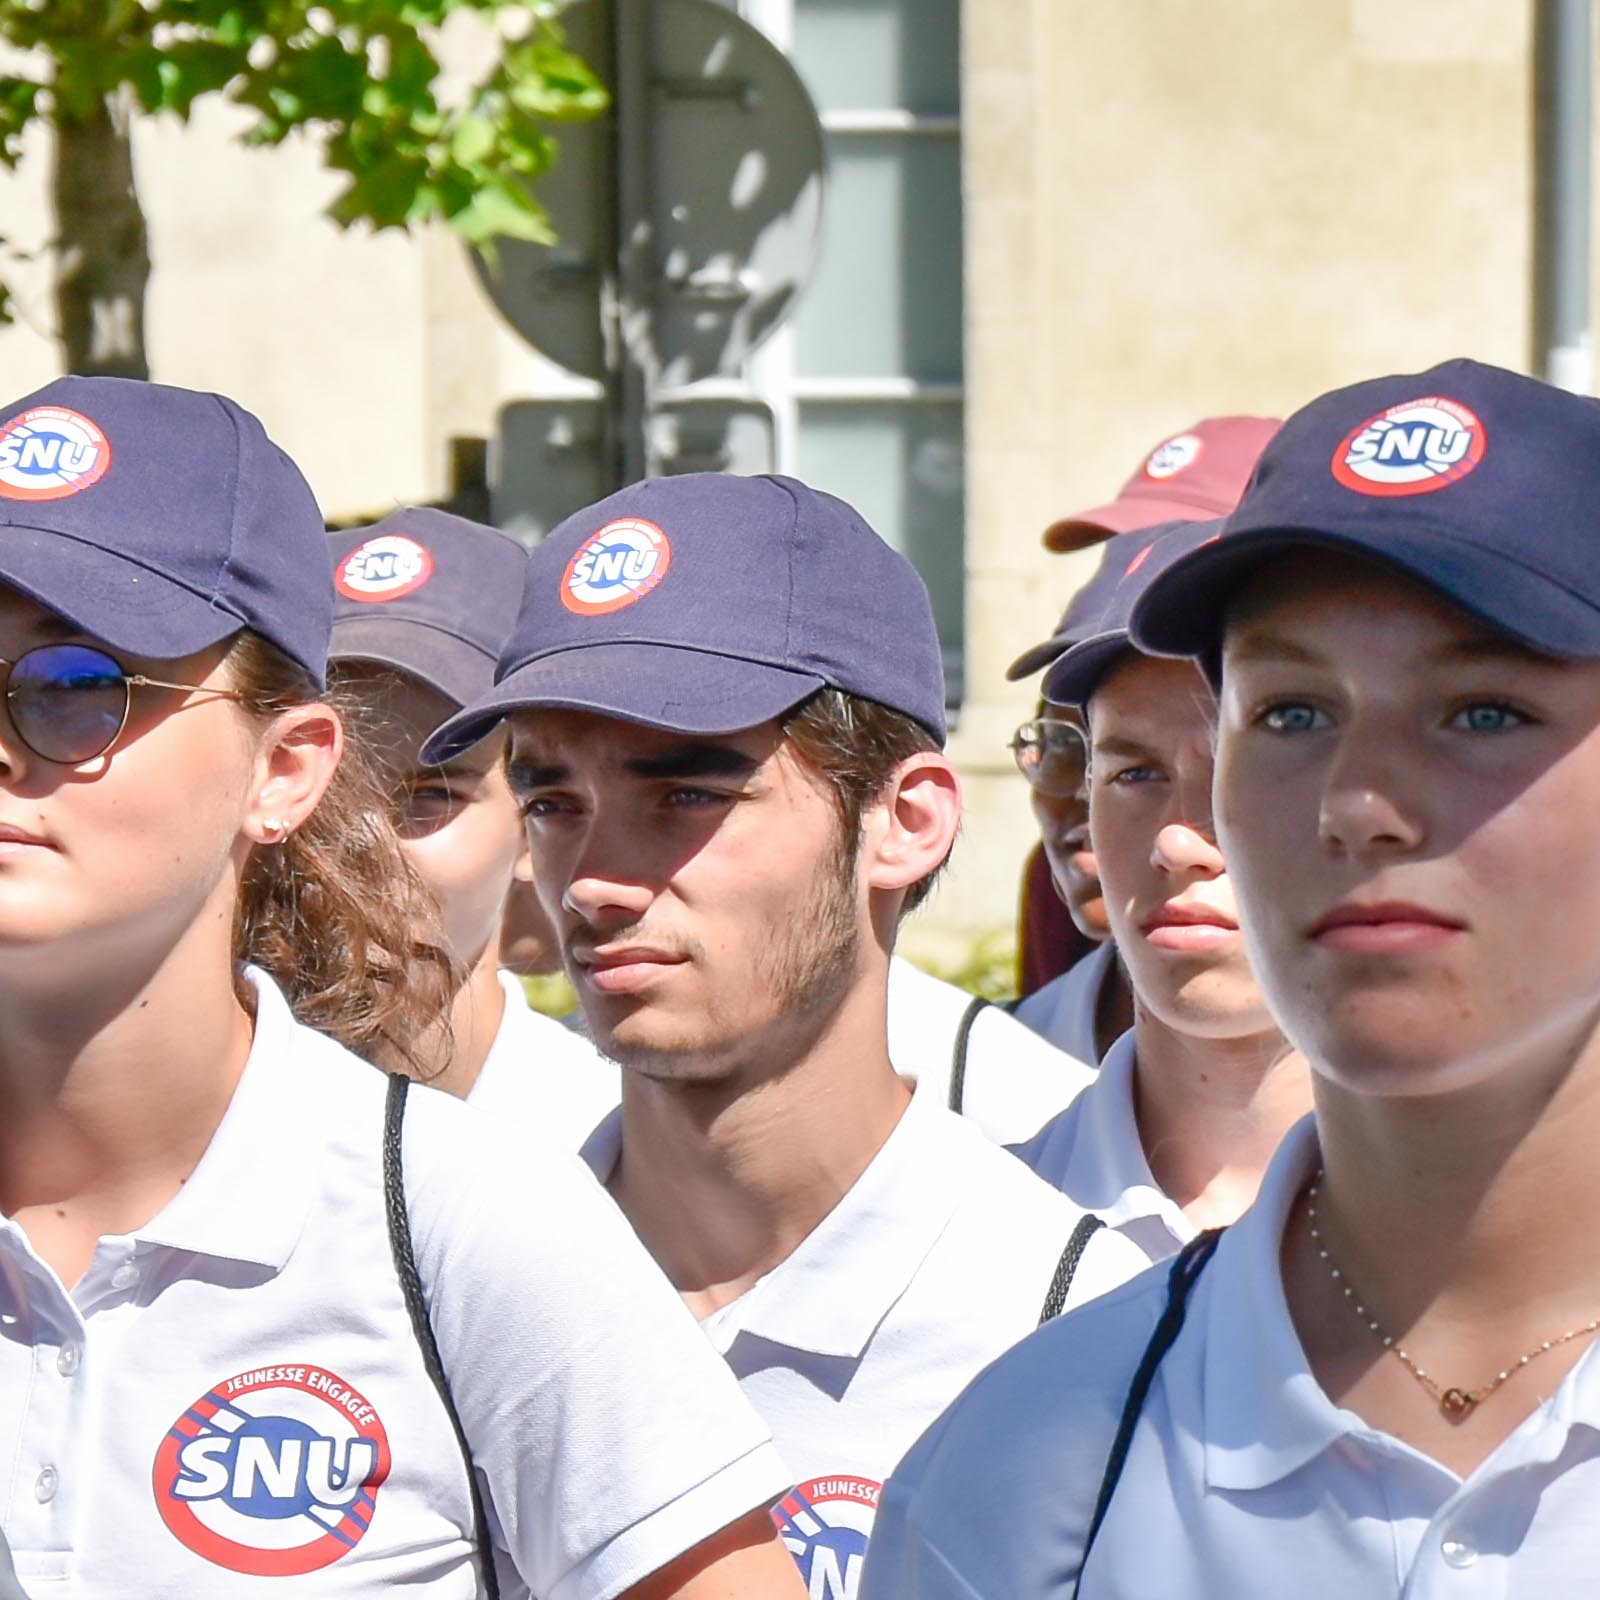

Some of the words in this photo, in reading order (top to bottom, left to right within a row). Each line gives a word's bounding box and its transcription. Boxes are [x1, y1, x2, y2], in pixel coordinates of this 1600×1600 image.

[1344, 427, 1473, 464] SNU
[343, 552, 423, 582] SNU
[568, 549, 660, 587] SNU
[226, 1367, 305, 1394] JEUNESSE
[306, 1371, 376, 1427] ENGAGÉE
[173, 1436, 373, 1506] SNU
